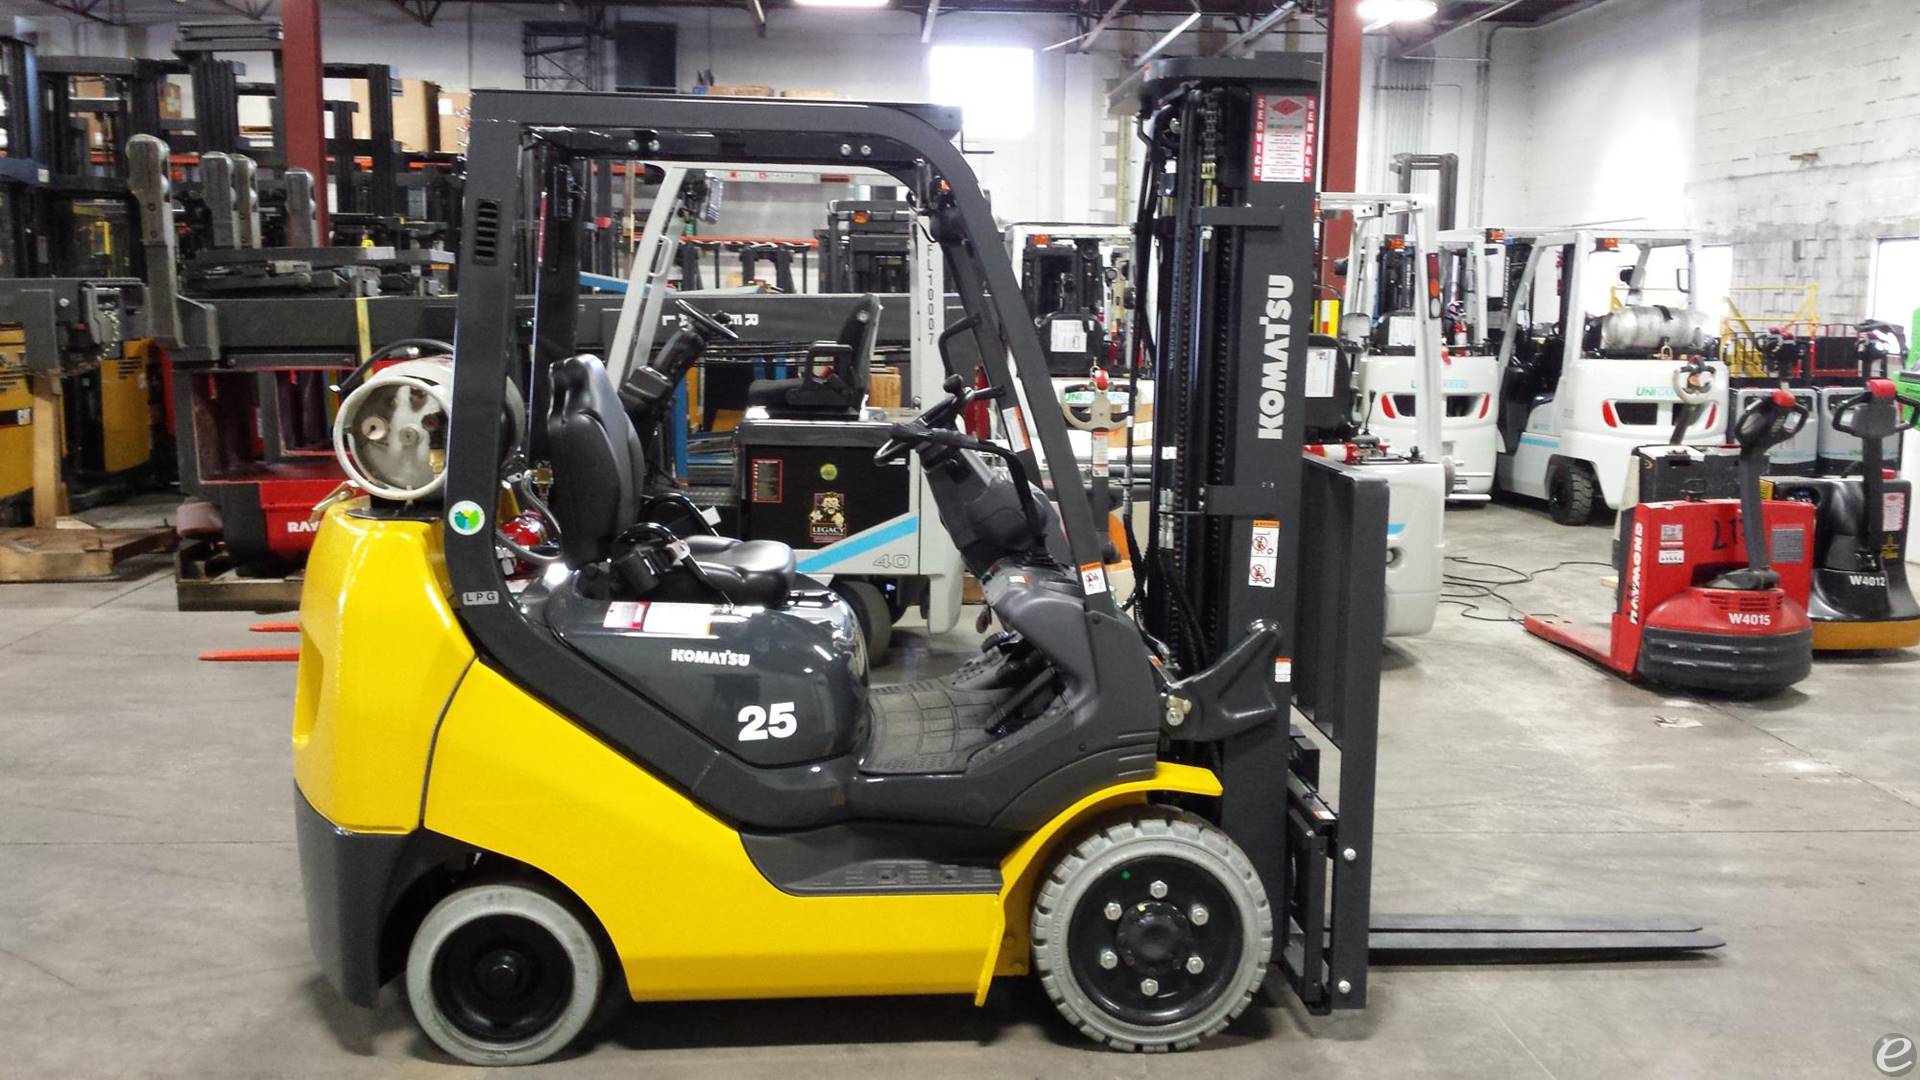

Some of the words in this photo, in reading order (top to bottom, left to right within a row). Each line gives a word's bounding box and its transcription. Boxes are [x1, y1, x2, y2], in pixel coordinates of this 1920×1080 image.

[1253, 98, 1265, 177] SERVICE
[1304, 99, 1316, 177] RENTALS
[1257, 274, 1294, 440] KOMATSU
[287, 521, 319, 533] RAY
[812, 526, 845, 534] LEGACY
[872, 553, 911, 569] 40
[1628, 522, 1644, 625] RAYMOND
[1849, 574, 1887, 587] W4012
[1728, 612, 1772, 626] W4015
[671, 649, 751, 667] KOMATSU
[737, 701, 798, 742] 25
